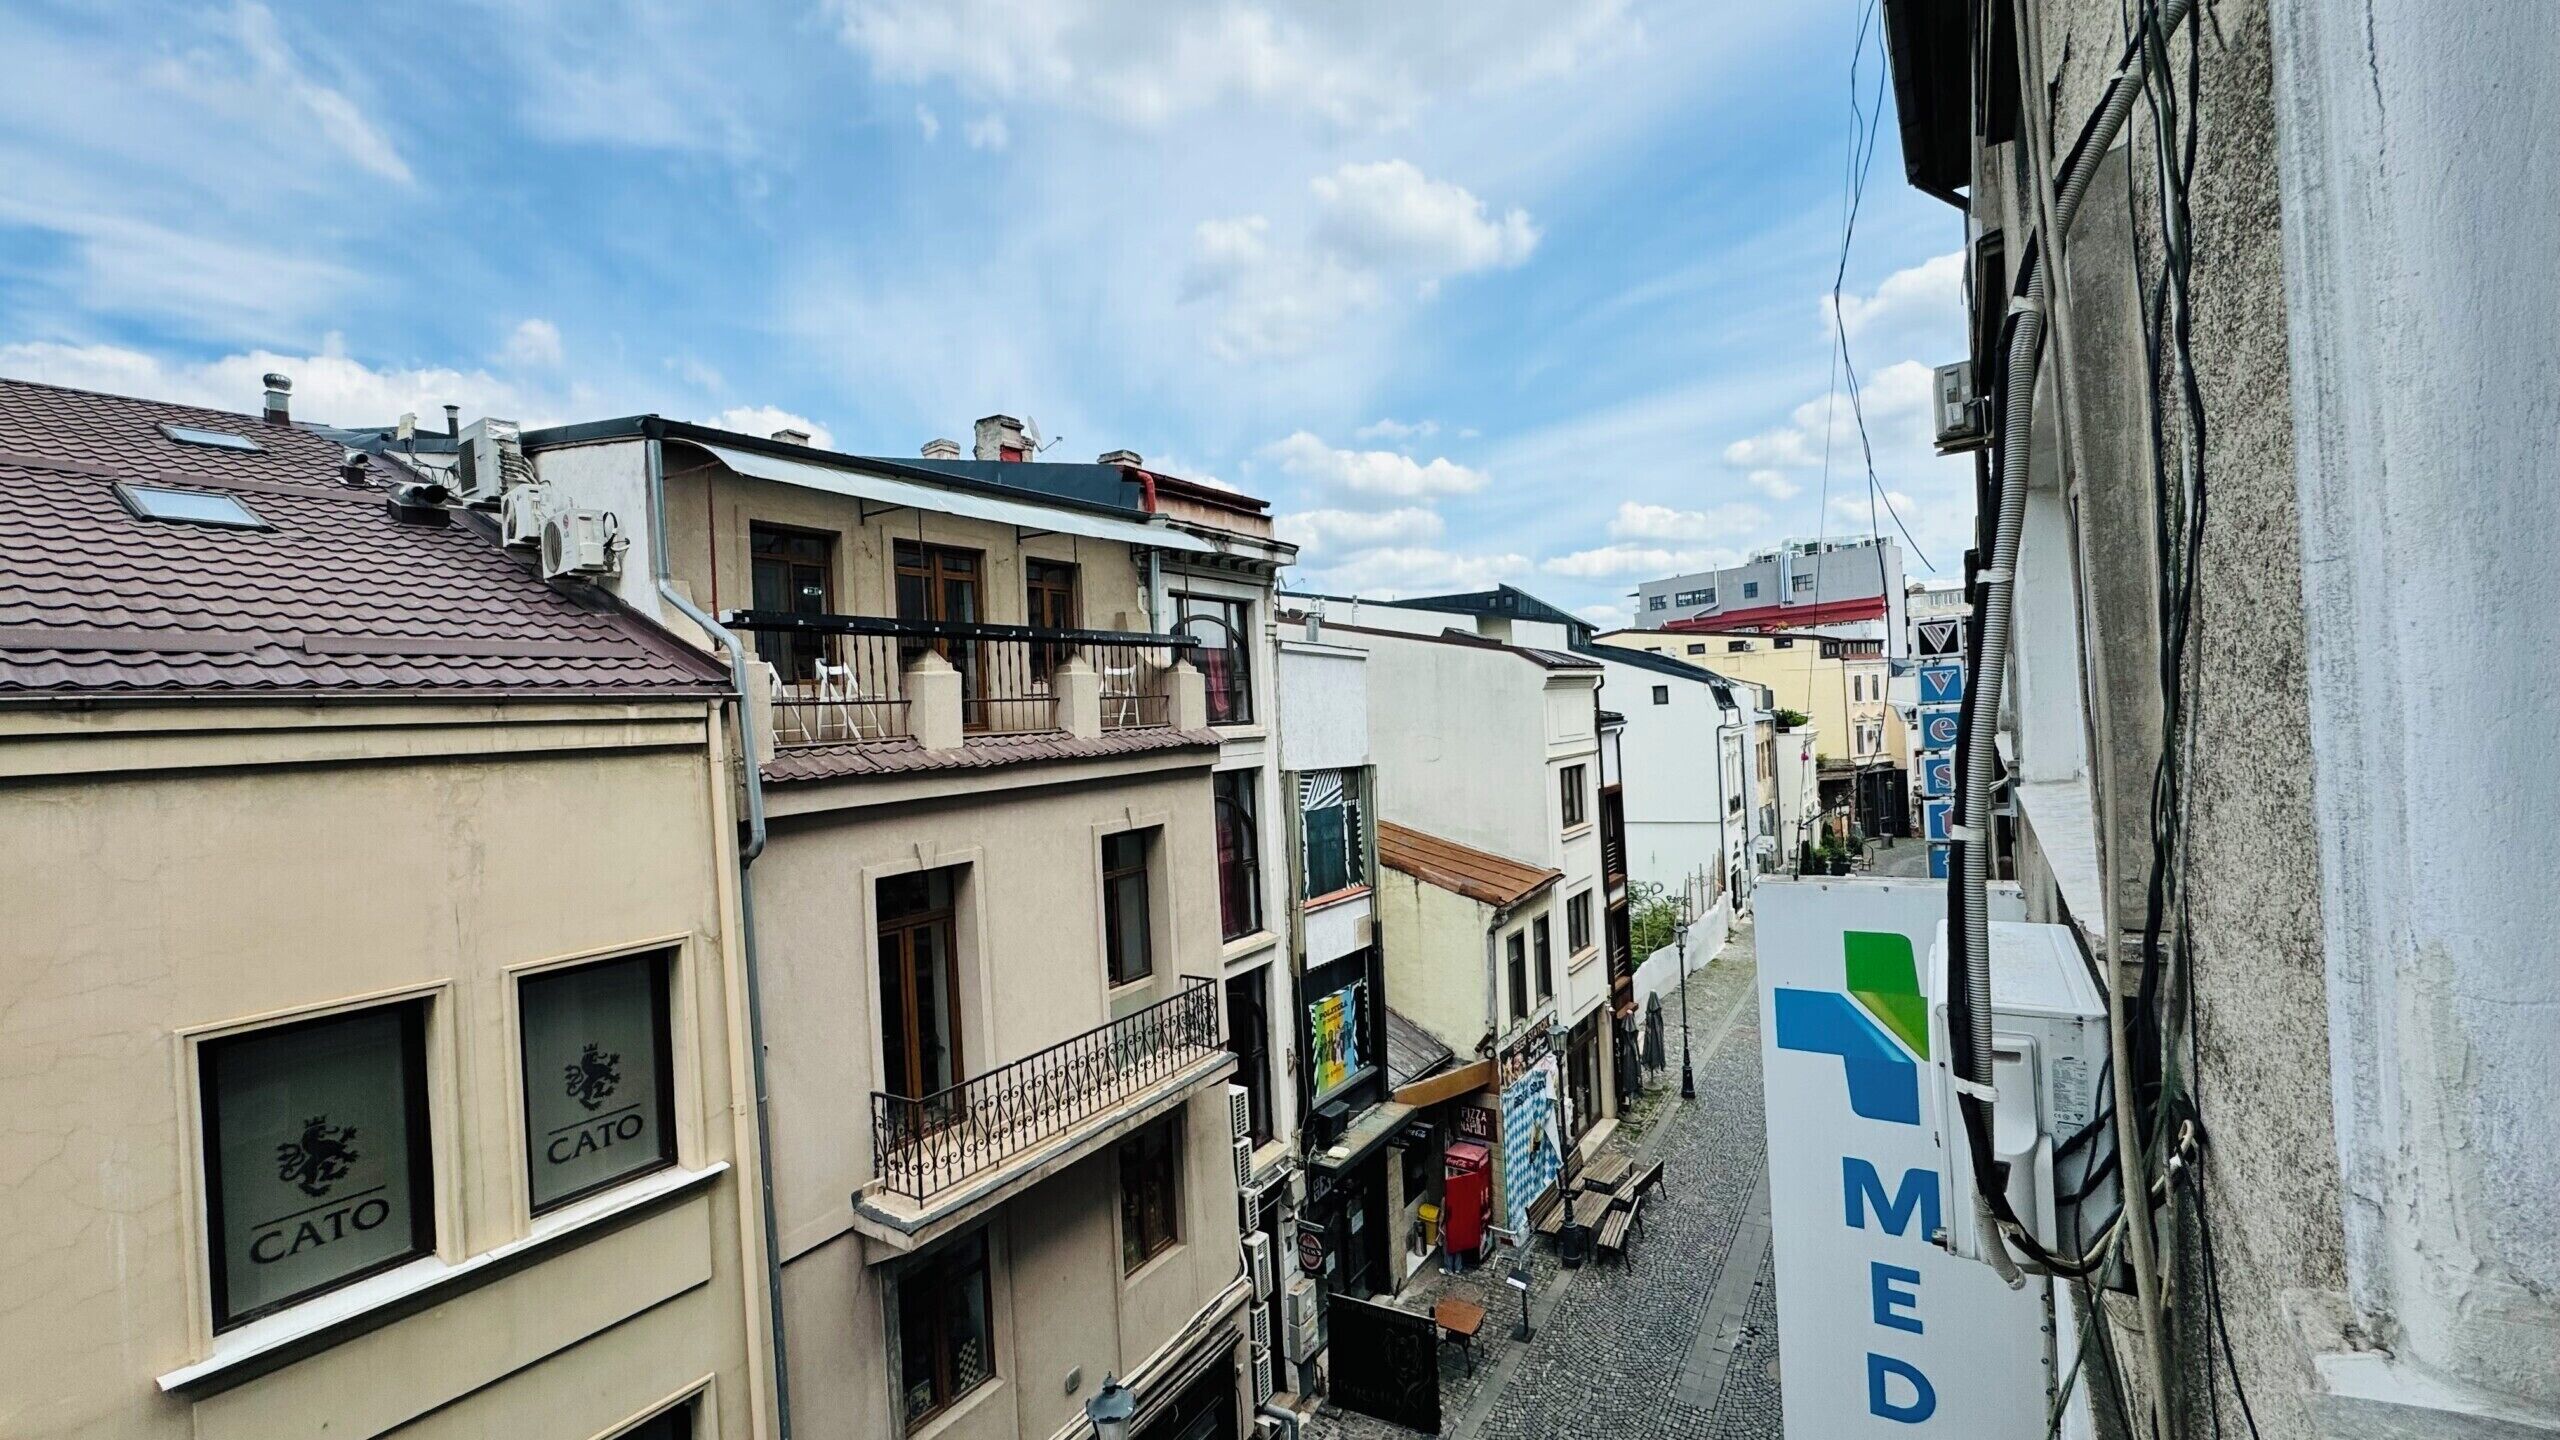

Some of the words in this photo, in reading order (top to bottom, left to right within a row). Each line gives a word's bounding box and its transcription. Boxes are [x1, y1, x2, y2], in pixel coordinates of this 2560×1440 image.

[547, 1113, 644, 1165] CATO
[1460, 1106, 1487, 1121] PIZZA
[249, 1198, 391, 1265] CATO
[1842, 1156, 1942, 1425] MED
